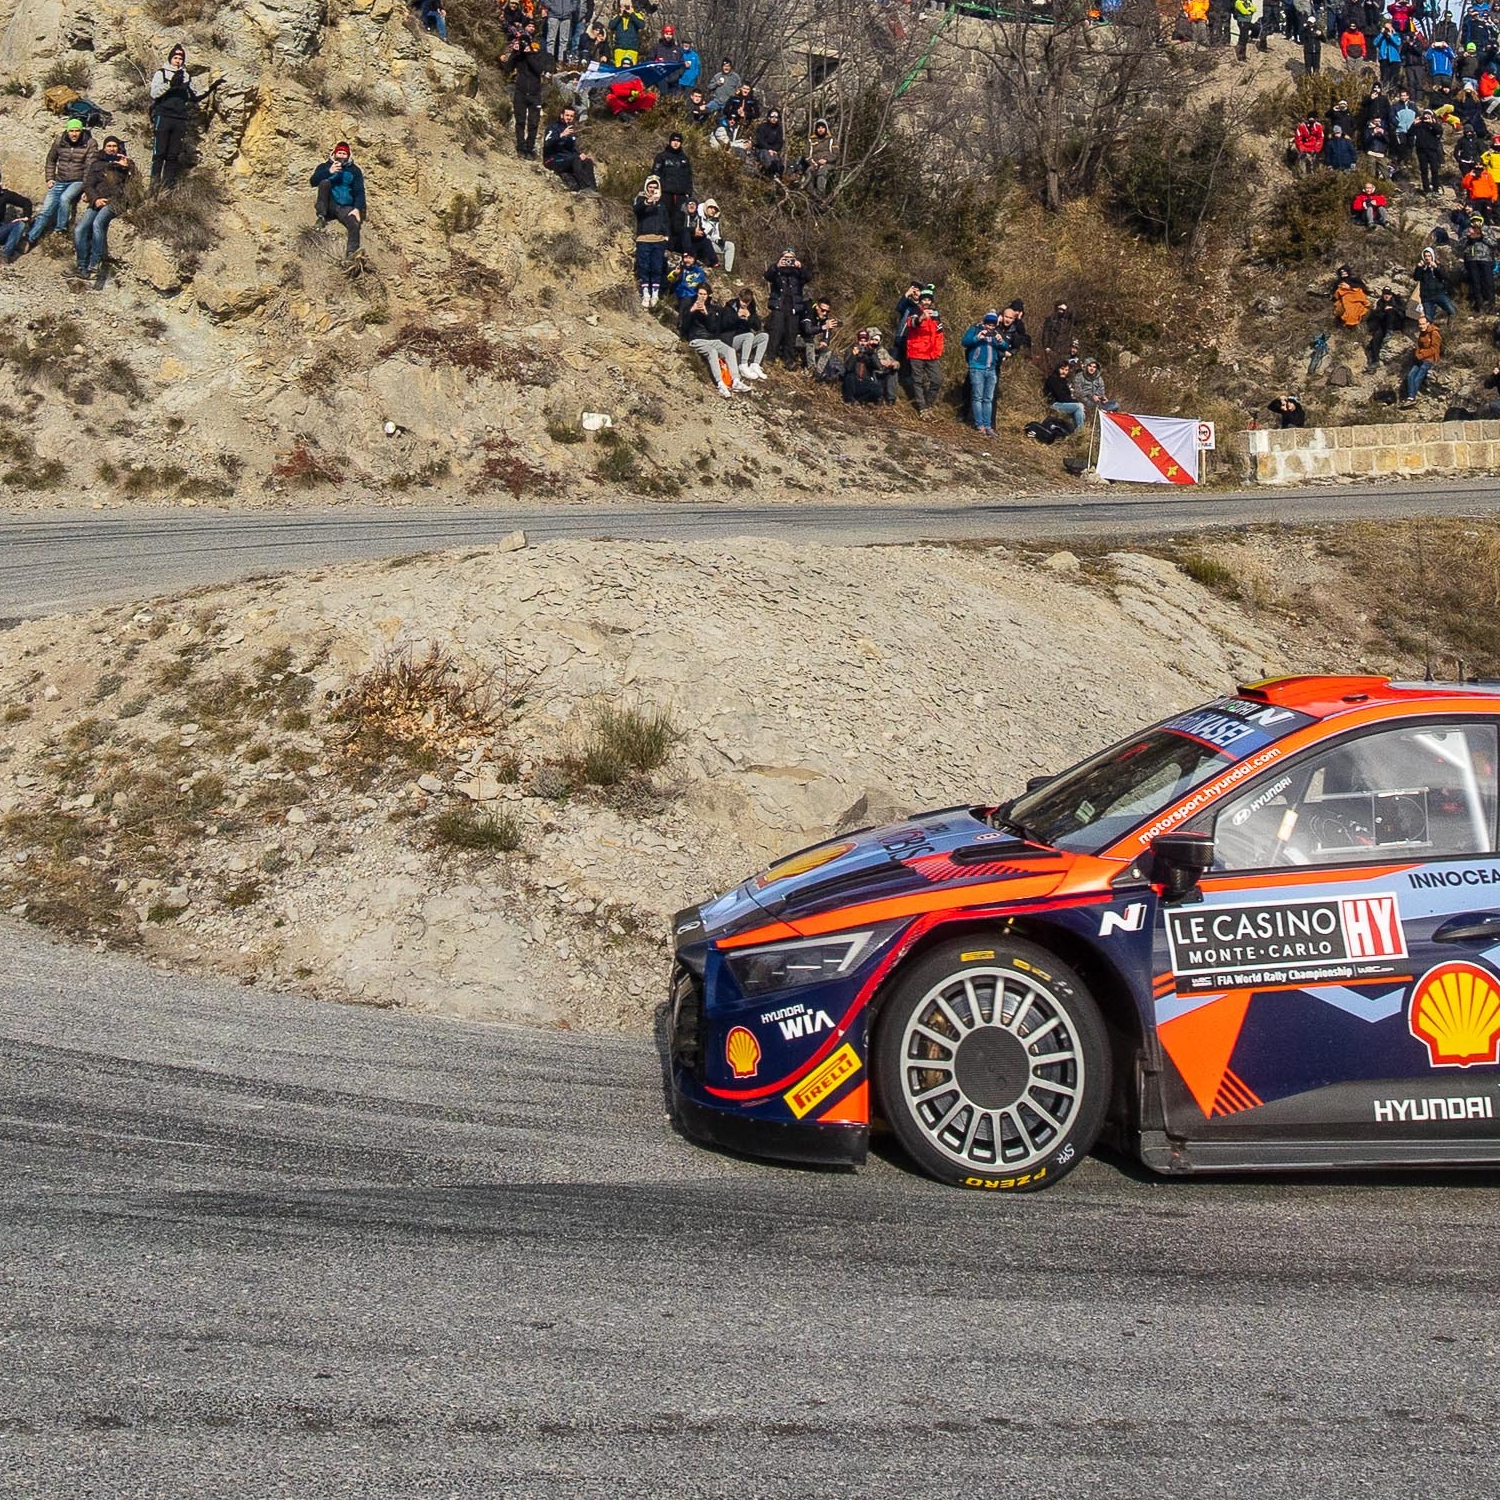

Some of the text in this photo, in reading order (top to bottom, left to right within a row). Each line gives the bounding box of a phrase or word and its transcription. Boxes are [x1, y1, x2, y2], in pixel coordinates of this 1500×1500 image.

[1138, 747, 1282, 845] motorsport.hyundai.com
[1250, 776, 1293, 812] HYUNDAI
[1174, 907, 1337, 946] LE CASINO
[1348, 899, 1400, 957] HY
[1188, 940, 1333, 964] MONTE CARLO
[1217, 974, 1234, 986] FIA
[1234, 972, 1263, 984] World
[1263, 969, 1288, 983] Rally
[1288, 964, 1353, 980] Championship
[761, 1003, 805, 1024] HYUNDAI
[792, 1052, 853, 1110] PIRELLI
[1373, 1096, 1493, 1122] HYUNDAI
